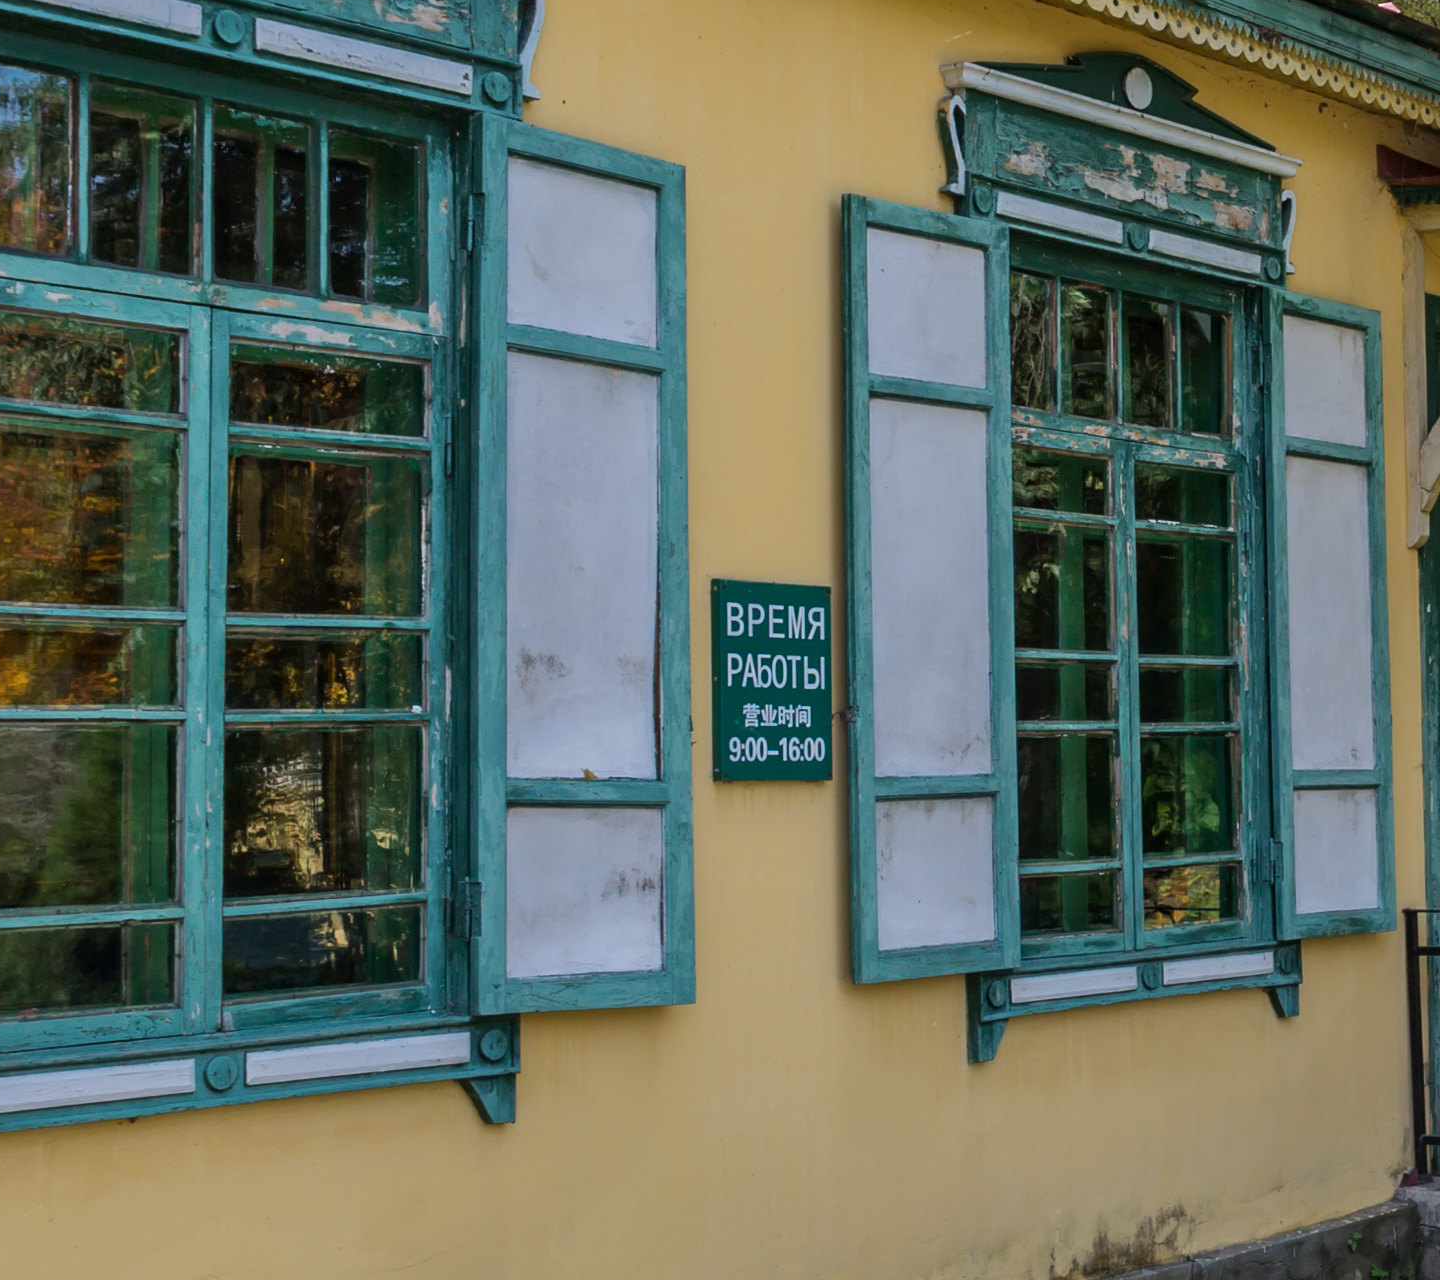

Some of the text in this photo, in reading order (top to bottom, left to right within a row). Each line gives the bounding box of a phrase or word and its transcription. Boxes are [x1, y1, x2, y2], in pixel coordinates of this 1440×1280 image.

[726, 602, 826, 640] ВРЕМЯ
[726, 653, 826, 690] РАБОТЫ
[743, 703, 812, 728] 营业时间
[729, 736, 826, 762] 9:00-16:00
